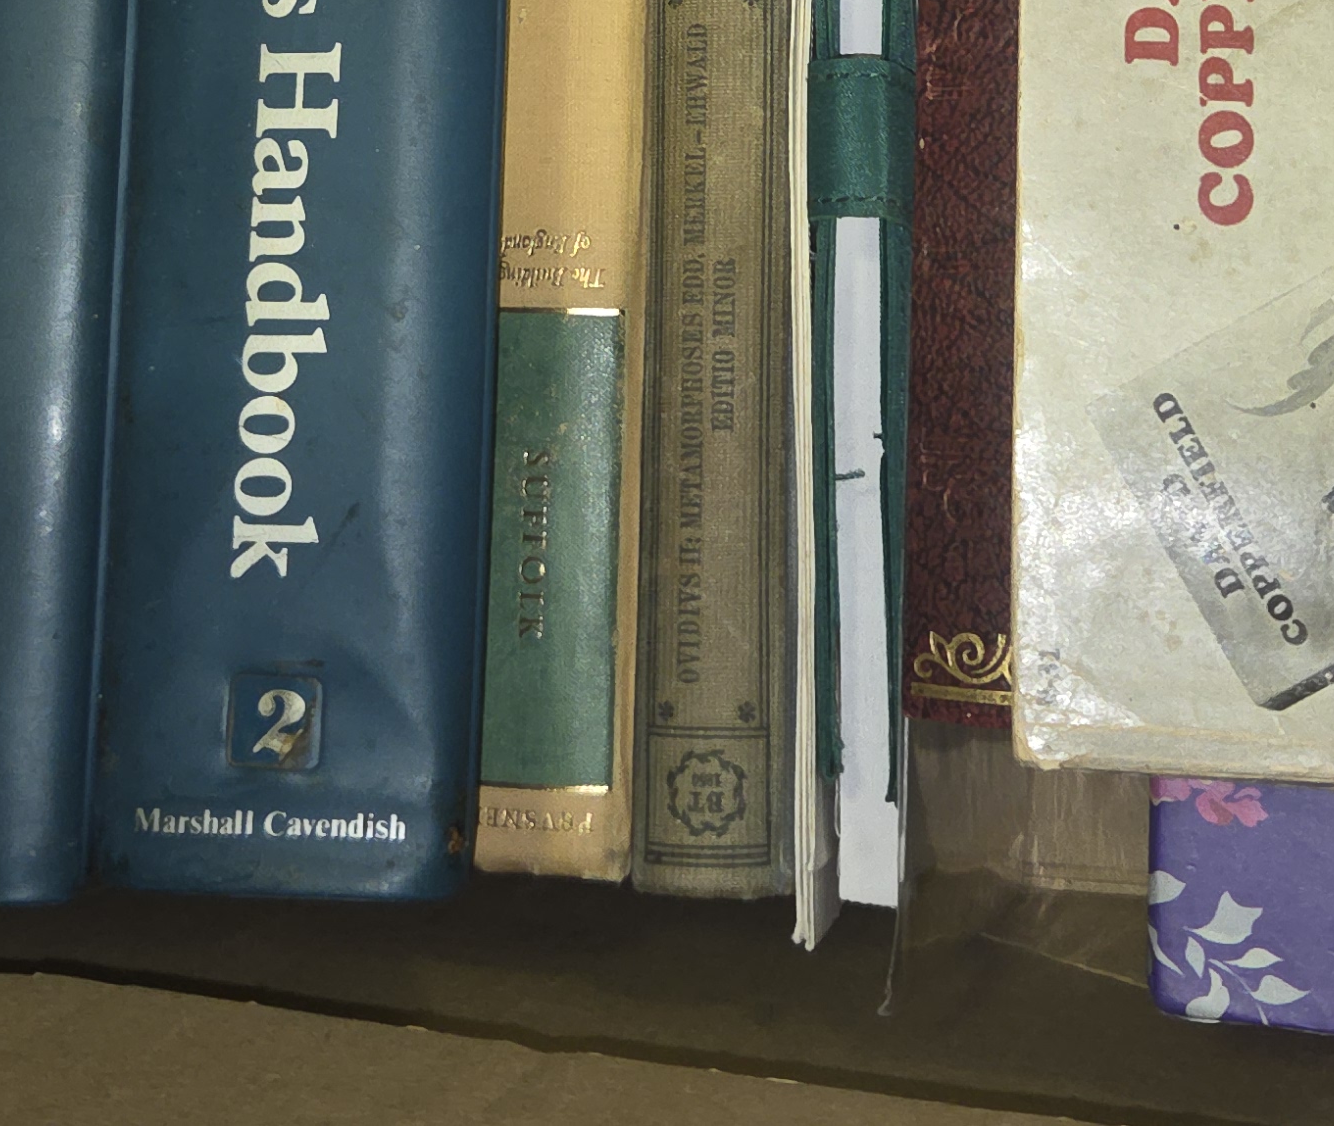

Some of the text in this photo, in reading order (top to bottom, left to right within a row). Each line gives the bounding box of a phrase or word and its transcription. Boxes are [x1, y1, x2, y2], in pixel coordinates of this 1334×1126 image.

[499, 261, 607, 289] The Building
[569, 231, 591, 258] of
[230, 42, 341, 579] Handbook
[710, 257, 737, 433] EDITIO MINOR
[679, 313, 705, 528] METAMORPHOSES
[517, 449, 550, 640] SUFFOLK
[677, 572, 701, 684] OVIDIVS
[251, 688, 307, 756] 2
[134, 806, 408, 842] Marshall Cavendish
[479, 806, 594, 836] PEVSNE
